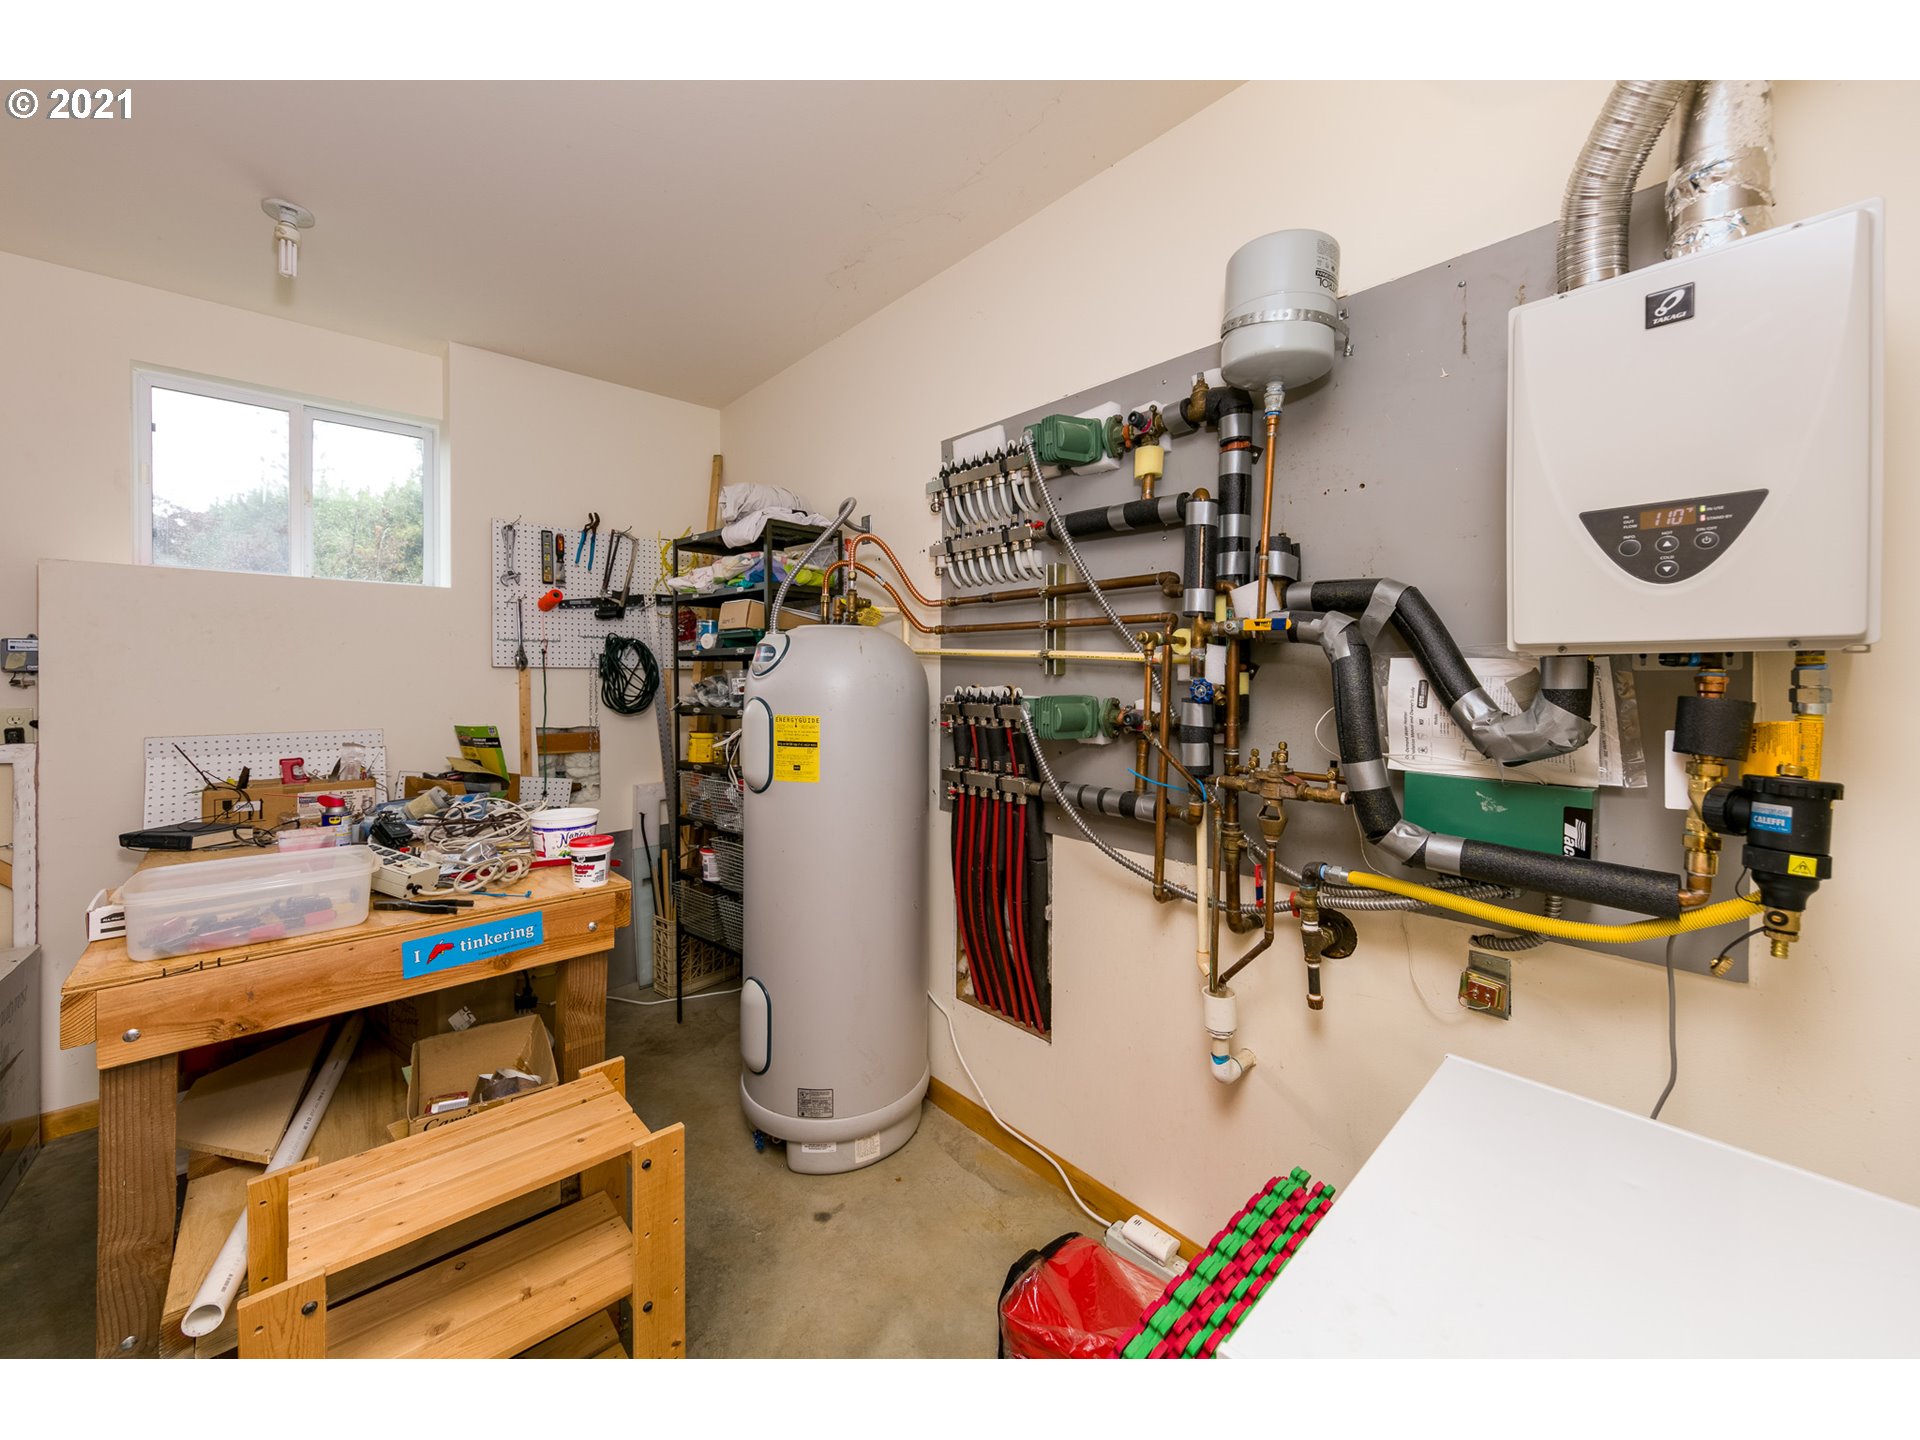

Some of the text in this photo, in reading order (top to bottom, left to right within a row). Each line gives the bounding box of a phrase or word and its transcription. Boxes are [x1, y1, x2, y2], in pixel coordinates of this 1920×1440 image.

[1652, 311, 1687, 325] TAKAGI
[1654, 508, 1684, 526] 110
[1753, 815, 1785, 827] CALEFFI
[1563, 818, 1587, 857] Tac
[413, 950, 421, 963] I
[459, 925, 535, 952] tinkering
